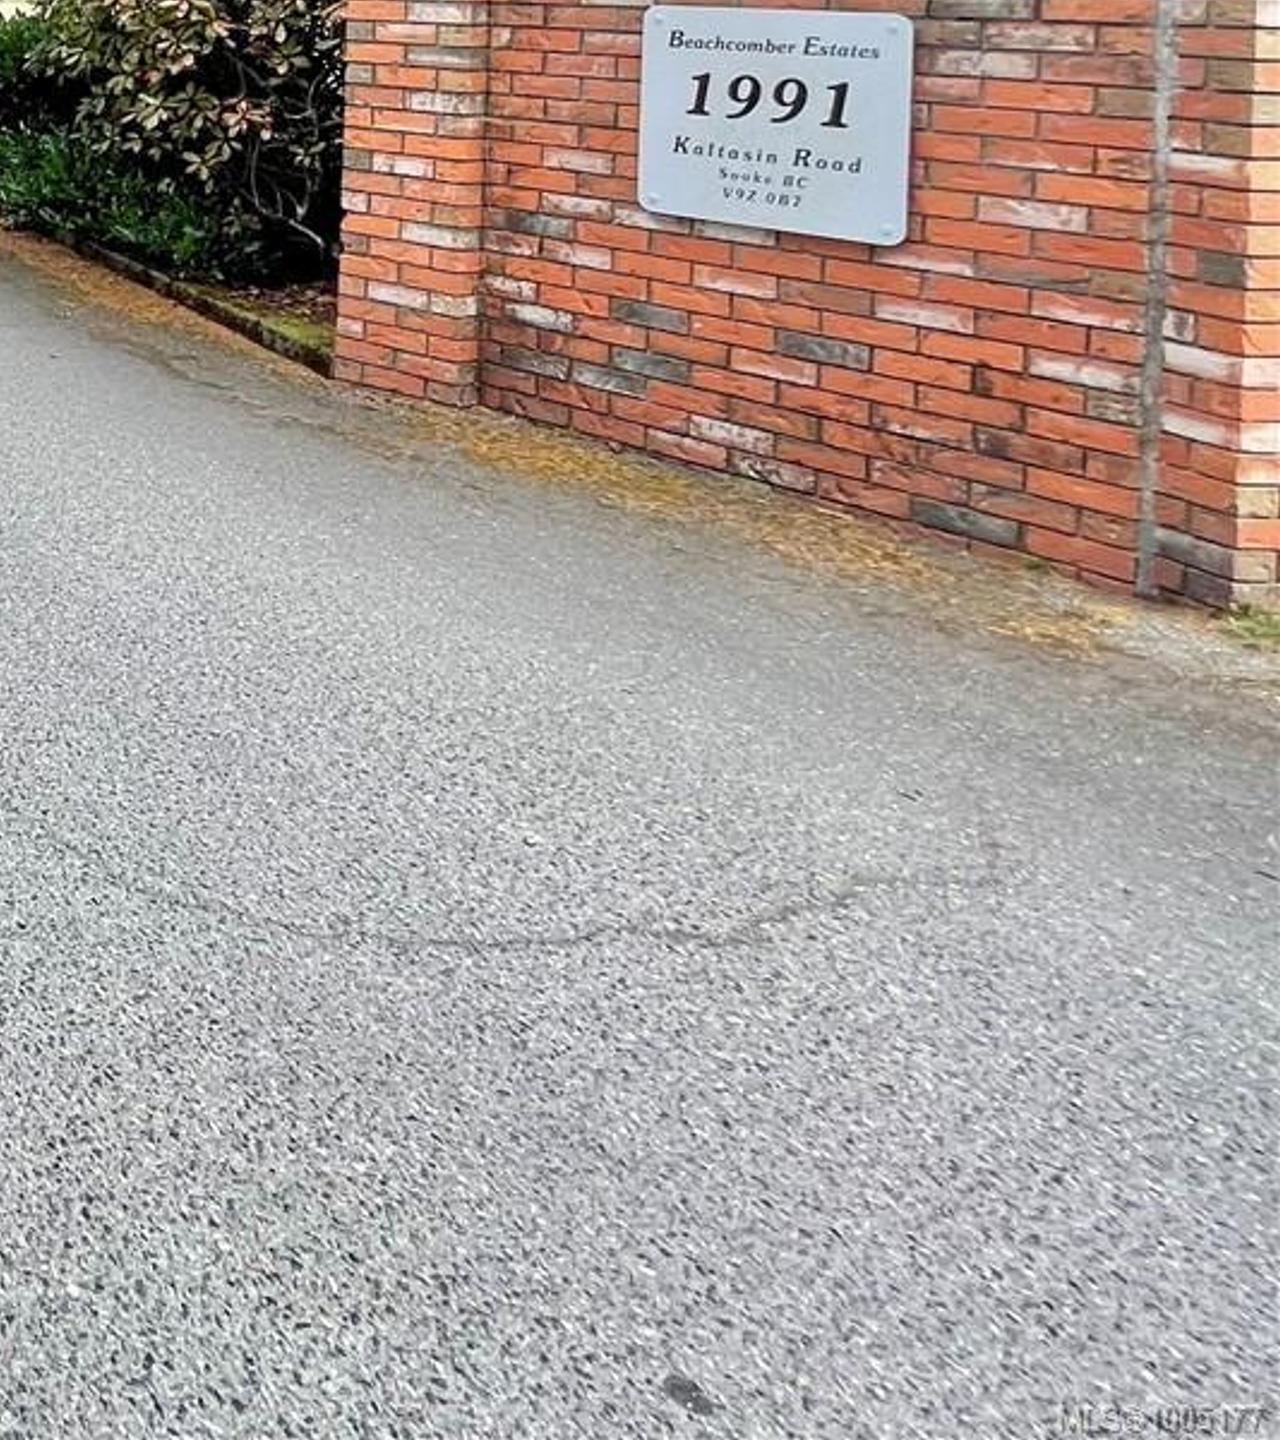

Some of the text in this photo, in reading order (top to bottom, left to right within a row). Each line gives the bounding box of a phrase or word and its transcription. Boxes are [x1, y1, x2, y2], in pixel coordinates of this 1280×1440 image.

[668, 30, 881, 59] Beachcomber Estates
[686, 72, 849, 129] 1991
[672, 136, 862, 174] Kaltasin Road
[719, 168, 810, 189] Sooke BC
[723, 187, 757, 202] V9Z
